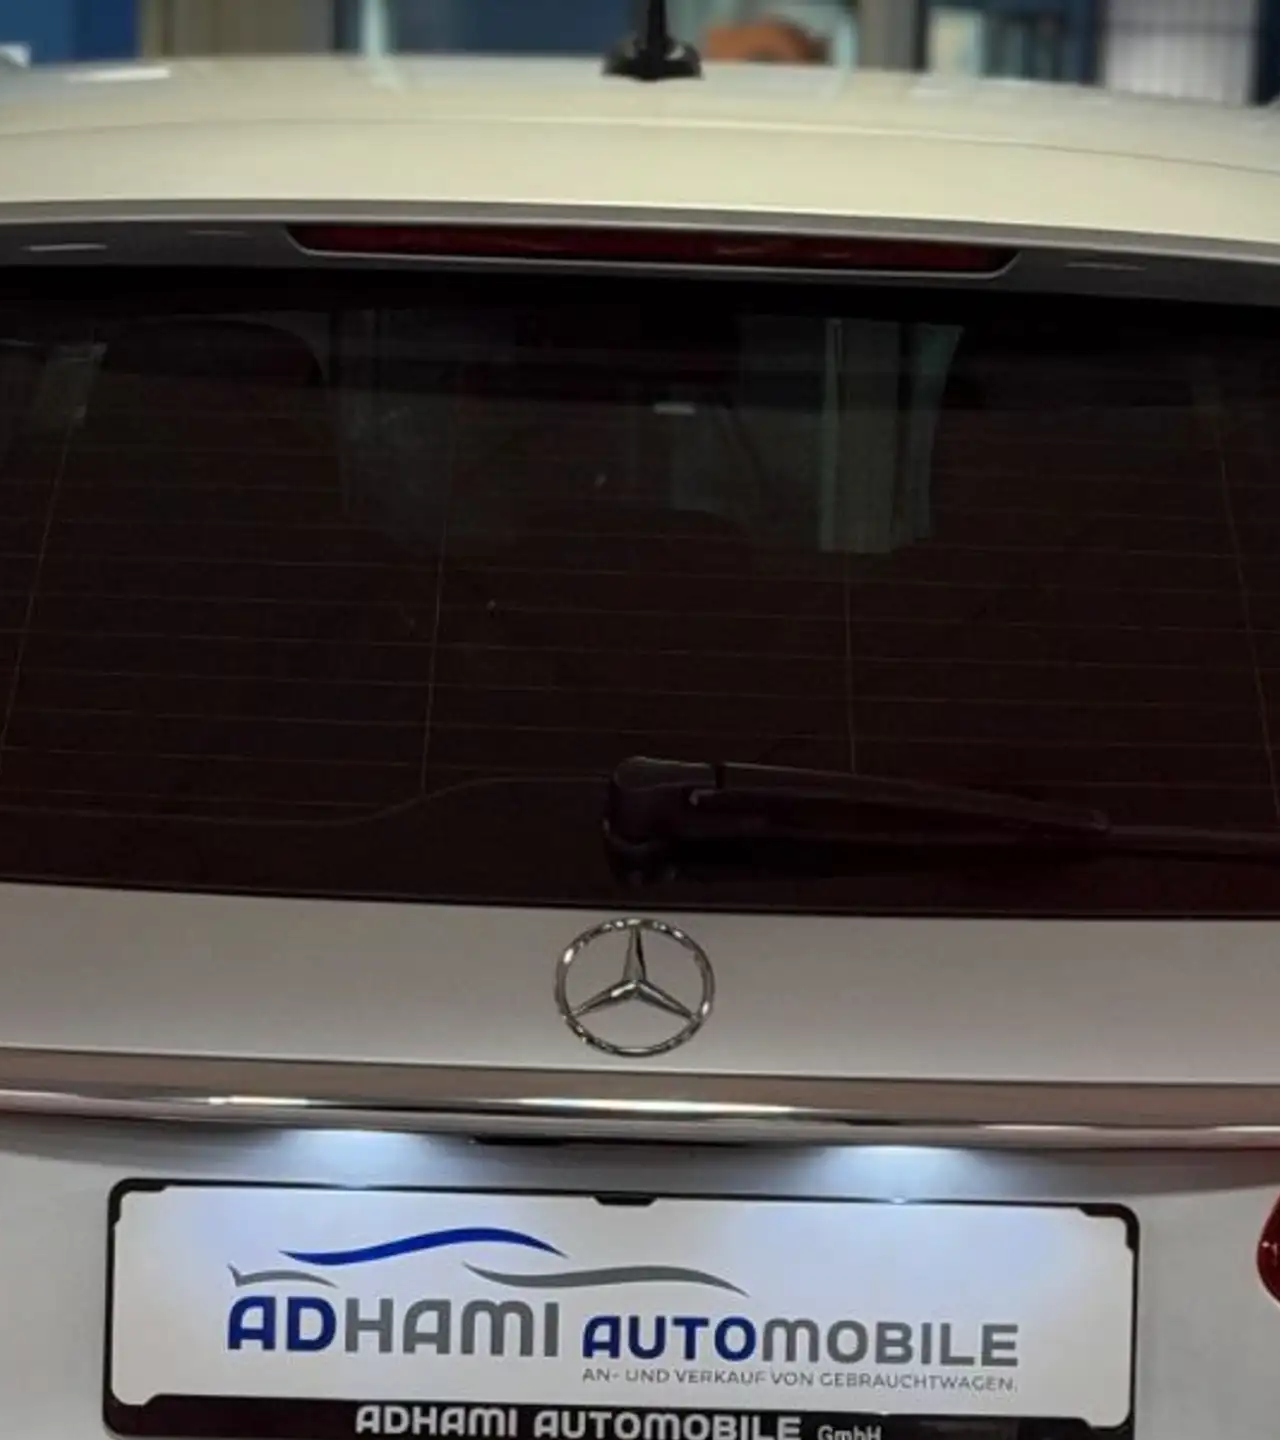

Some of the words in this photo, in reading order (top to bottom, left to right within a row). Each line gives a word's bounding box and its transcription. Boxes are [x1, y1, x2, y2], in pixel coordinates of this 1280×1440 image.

[227, 1295, 559, 1358] ADHAMI
[581, 1314, 1019, 1367] AUTOMOBILE
[581, 1367, 620, 1383] AN-
[624, 1368, 670, 1384] UND
[674, 1369, 767, 1387] VERKAUF
[770, 1371, 815, 1387] VON
[354, 1404, 518, 1438] ADHAMI
